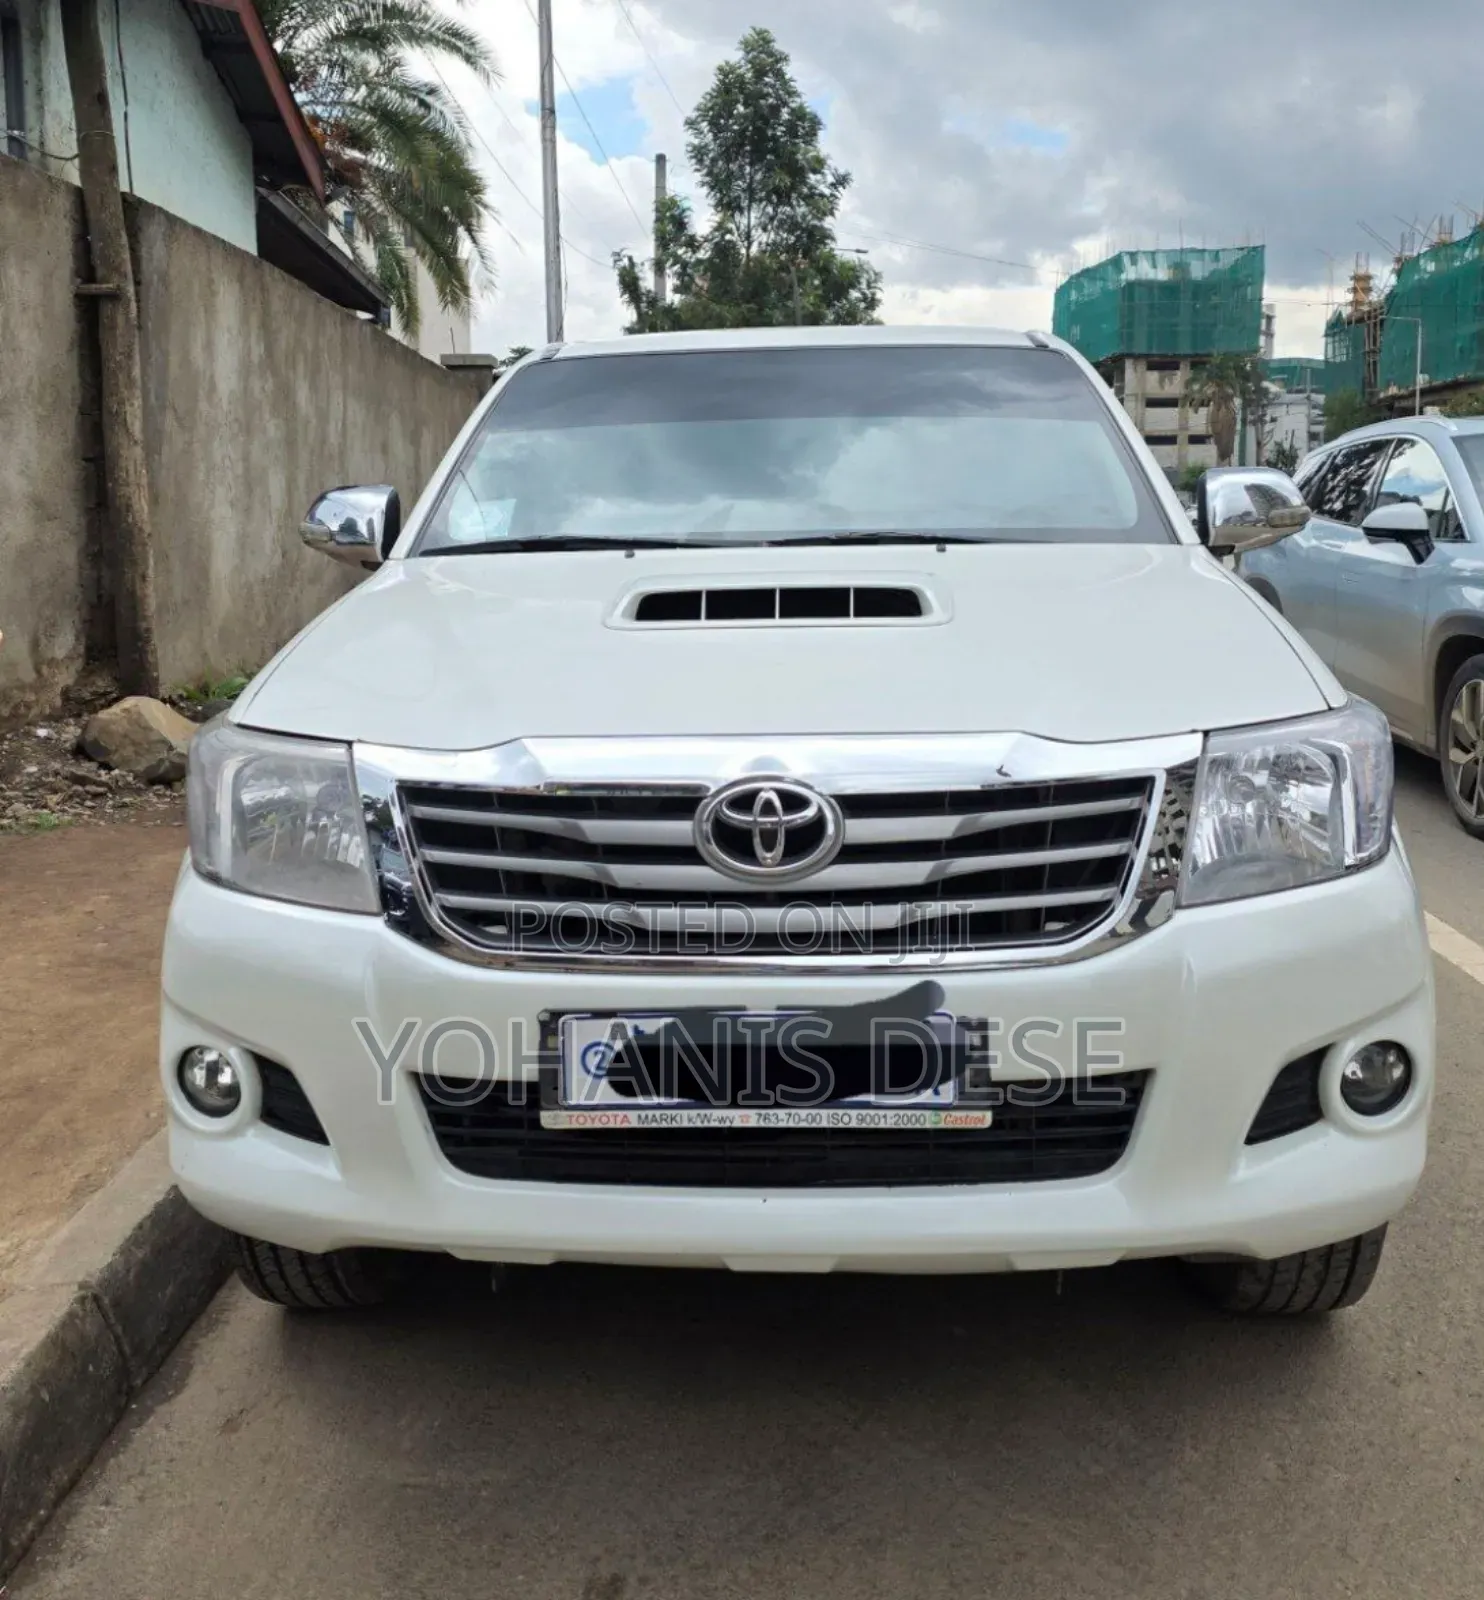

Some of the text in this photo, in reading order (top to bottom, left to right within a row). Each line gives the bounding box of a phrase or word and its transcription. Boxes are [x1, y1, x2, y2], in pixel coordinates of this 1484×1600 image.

[567, 1113, 632, 1126] TOYOTA
[637, 1112, 683, 1126] MARKI
[755, 1112, 823, 1125] 763-70-00
[827, 1112, 852, 1125] ISO
[855, 1112, 927, 1125] 9001:2000
[943, 1112, 987, 1126] Castrol
